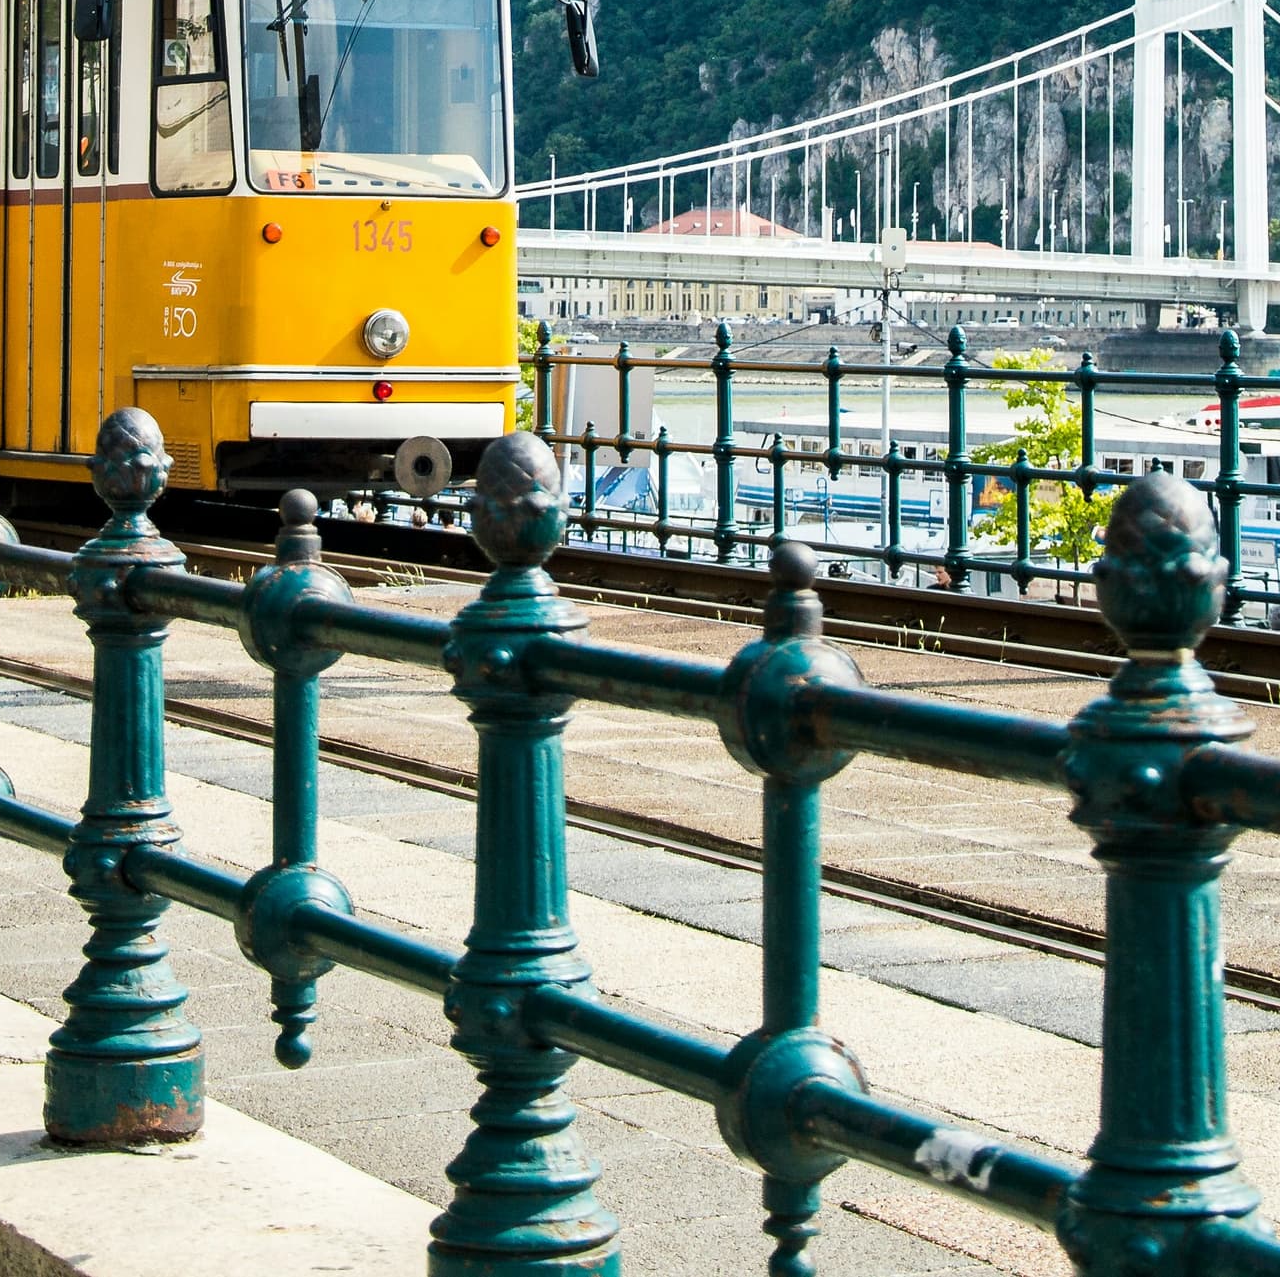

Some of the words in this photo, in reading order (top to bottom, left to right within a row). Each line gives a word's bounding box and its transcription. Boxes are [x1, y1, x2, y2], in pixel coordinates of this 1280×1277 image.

[277, 173, 306, 189] F6
[352, 219, 414, 253] 1345
[172, 307, 197, 338] 50
